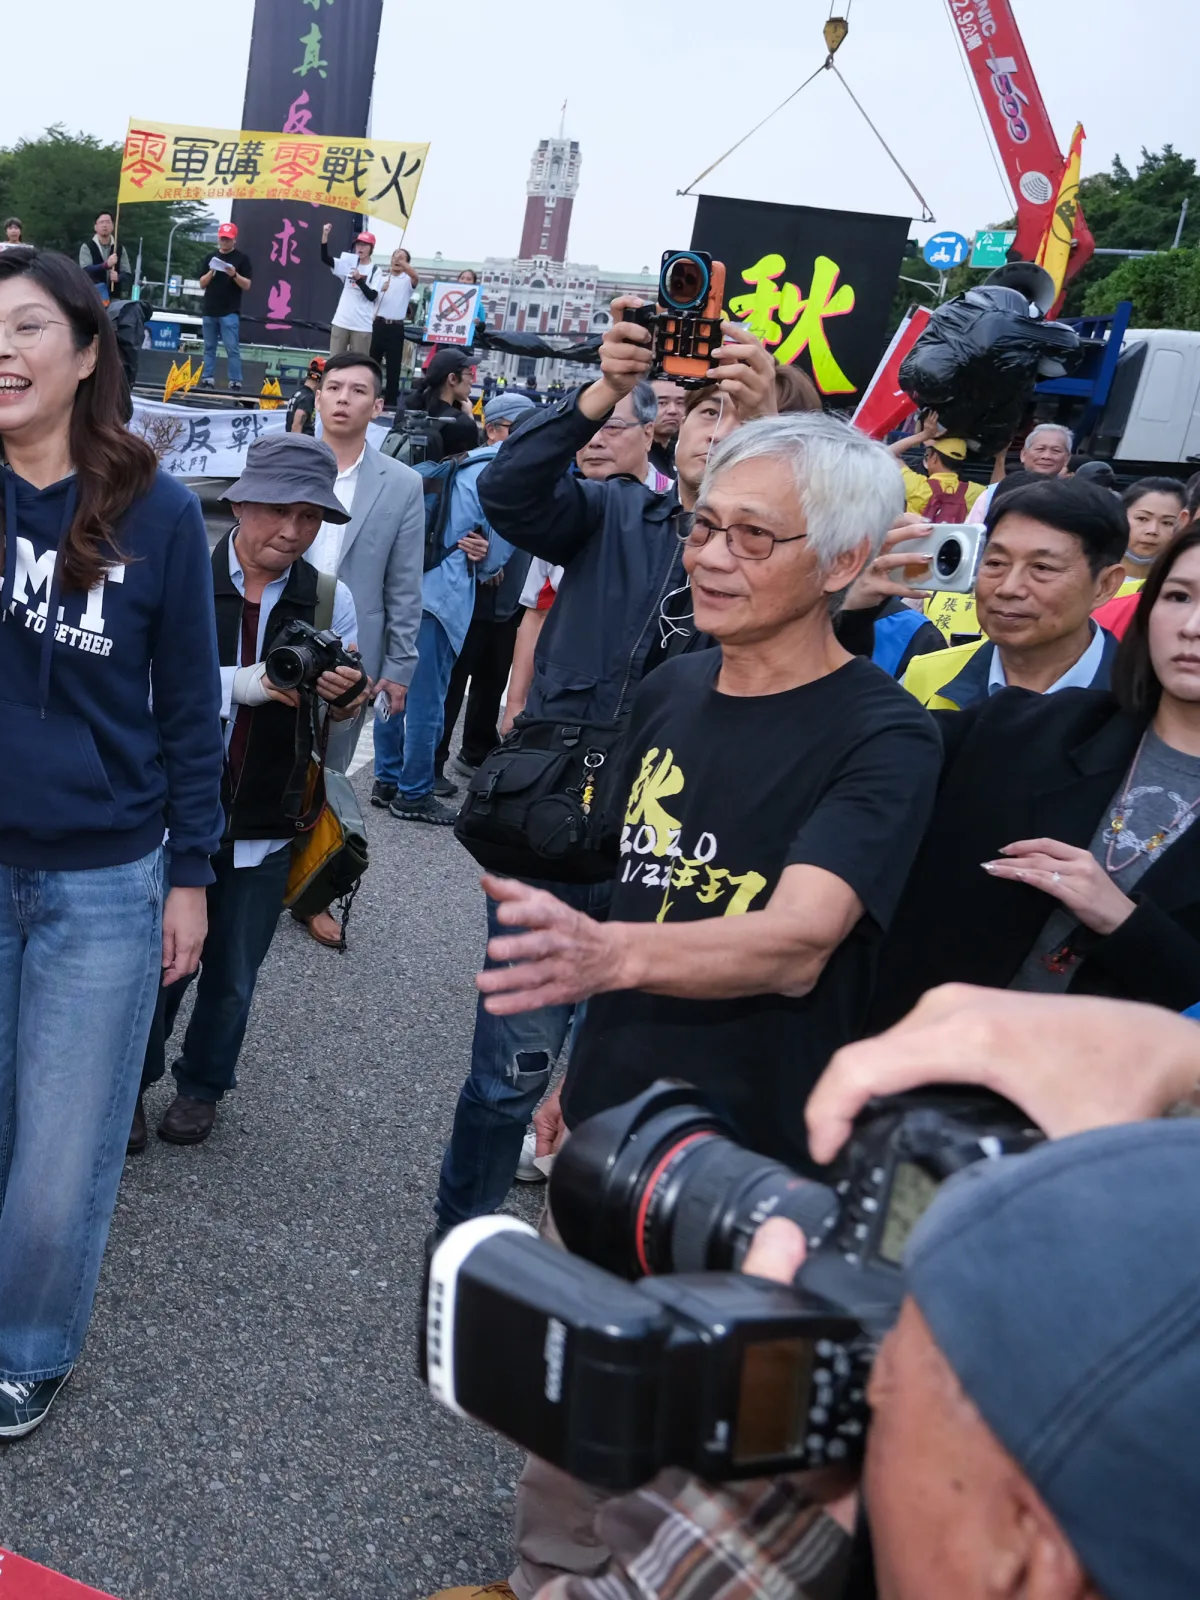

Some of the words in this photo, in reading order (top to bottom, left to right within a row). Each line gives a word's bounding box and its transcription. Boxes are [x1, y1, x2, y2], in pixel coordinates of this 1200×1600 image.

[121, 129, 421, 219] 零軍購零戰火
[728, 253, 858, 395] 秋
